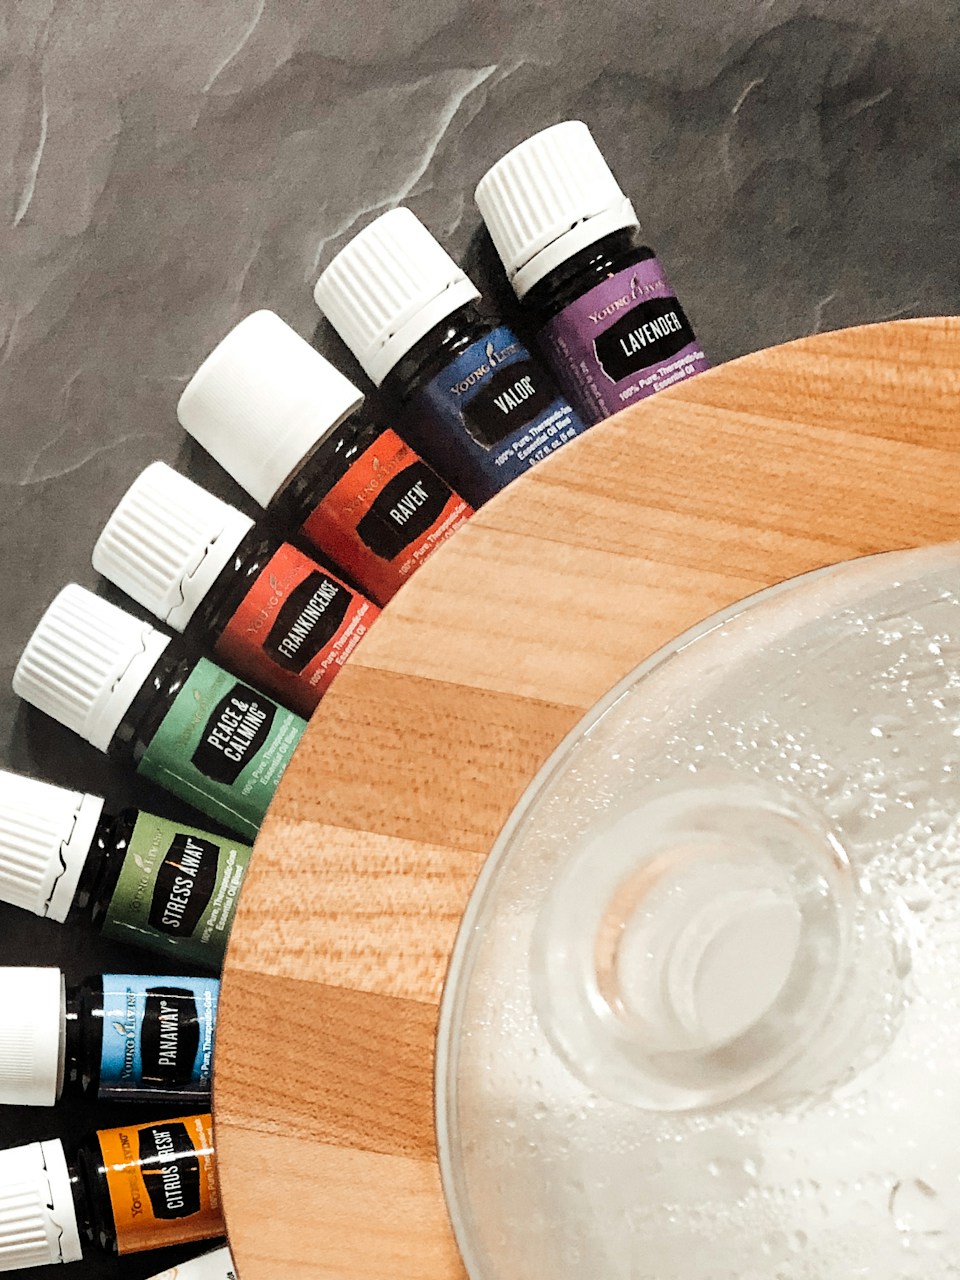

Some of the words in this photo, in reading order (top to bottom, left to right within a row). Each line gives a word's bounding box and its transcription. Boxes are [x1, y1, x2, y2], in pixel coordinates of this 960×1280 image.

[587, 295, 630, 325] YOUNG
[618, 310, 682, 357] LAVENDER
[450, 363, 490, 398] YOUNG
[412, 540, 432, 560] Pure,
[277, 579, 339, 658] FRANKINCENSE
[335, 633, 361, 666] Essential
[356, 624, 366, 635] Oil
[308, 666, 325, 686] 100%
[320, 648, 339, 669] Pure,
[206, 705, 244, 750] PEACE
[229, 696, 249, 712] &
[160, 876, 194, 928] STRESS
[207, 905, 220, 926] Pure,
[215, 896, 233, 931] Essential
[227, 885, 237, 897] Oil
[122, 1039, 134, 1078] YOUNG
[201, 1051, 211, 1070] Pure,
[160, 1164, 184, 1210] CITRUS
